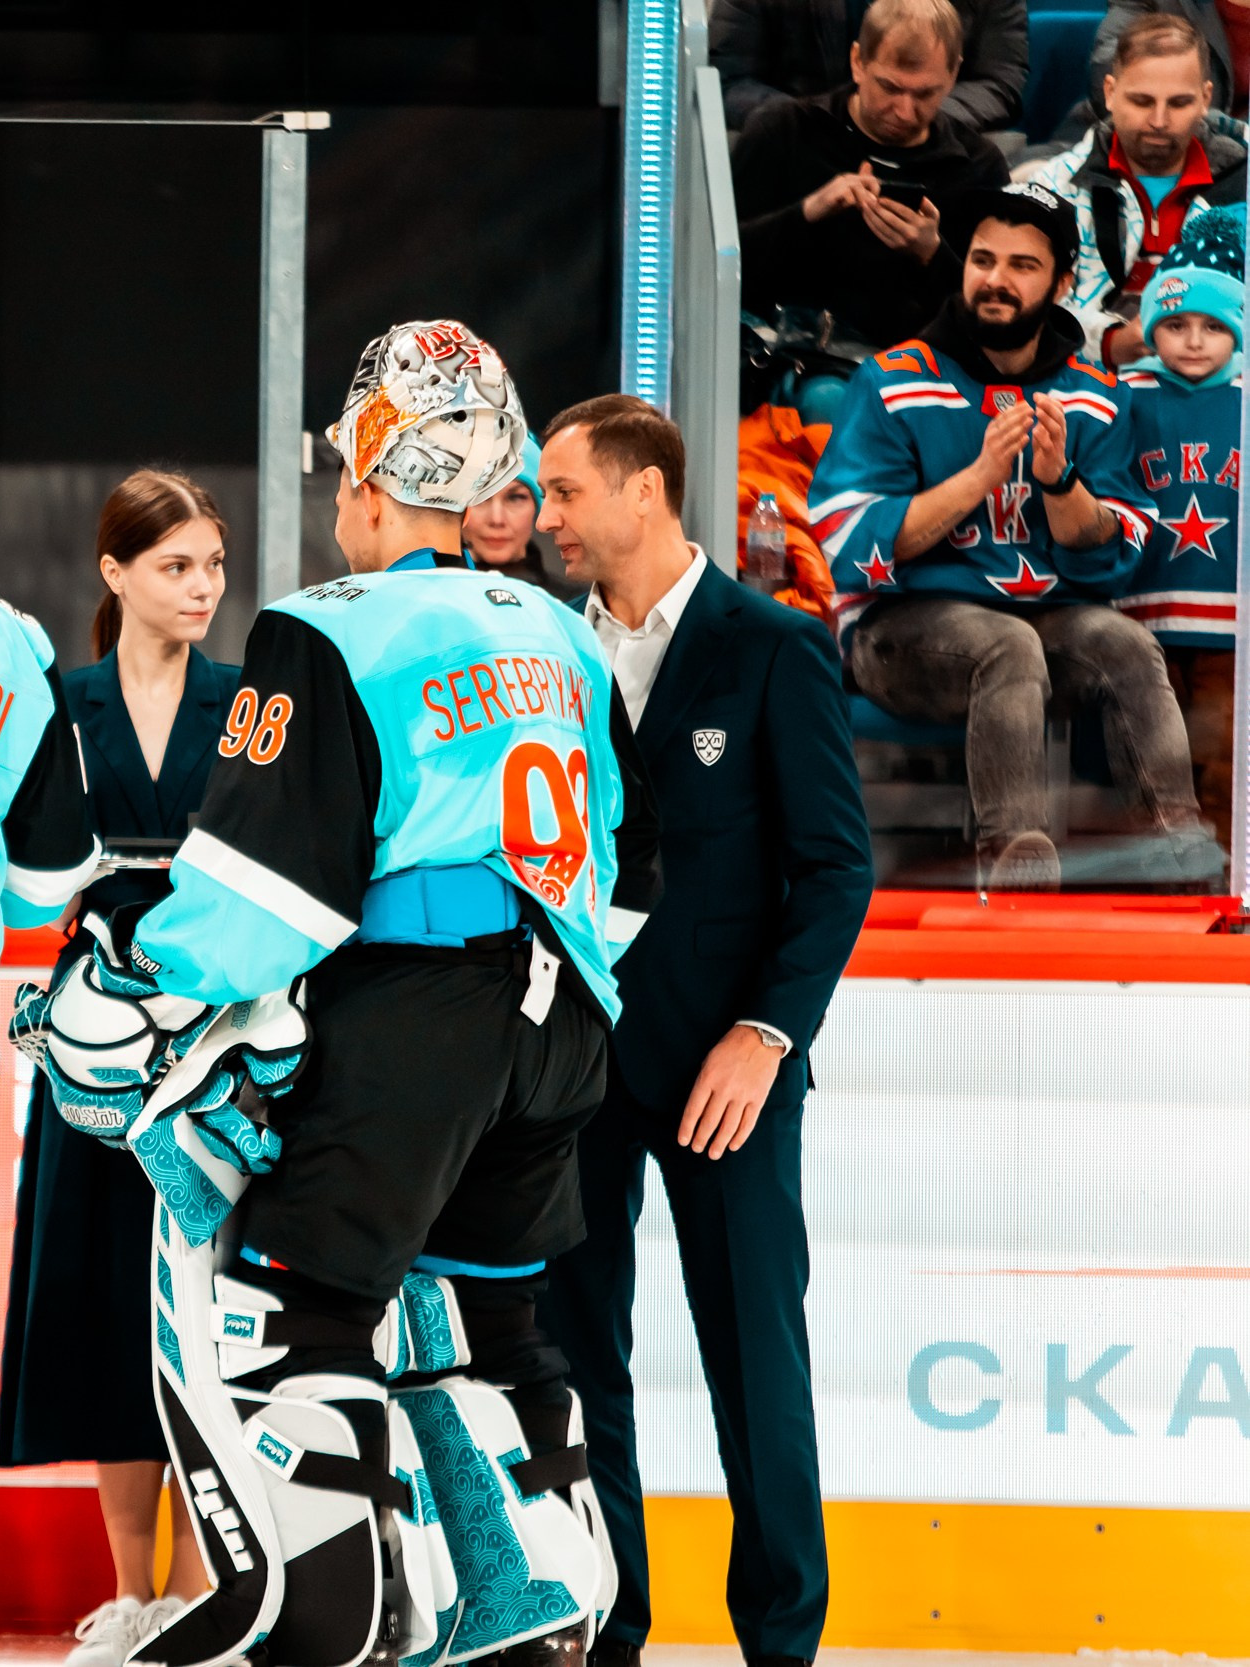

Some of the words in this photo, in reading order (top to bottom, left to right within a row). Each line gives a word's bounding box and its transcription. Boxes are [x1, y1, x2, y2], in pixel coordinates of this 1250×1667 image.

[1139, 442, 1240, 492] СКА
[218, 687, 293, 765] 98
[907, 1340, 1250, 1439] СКА
